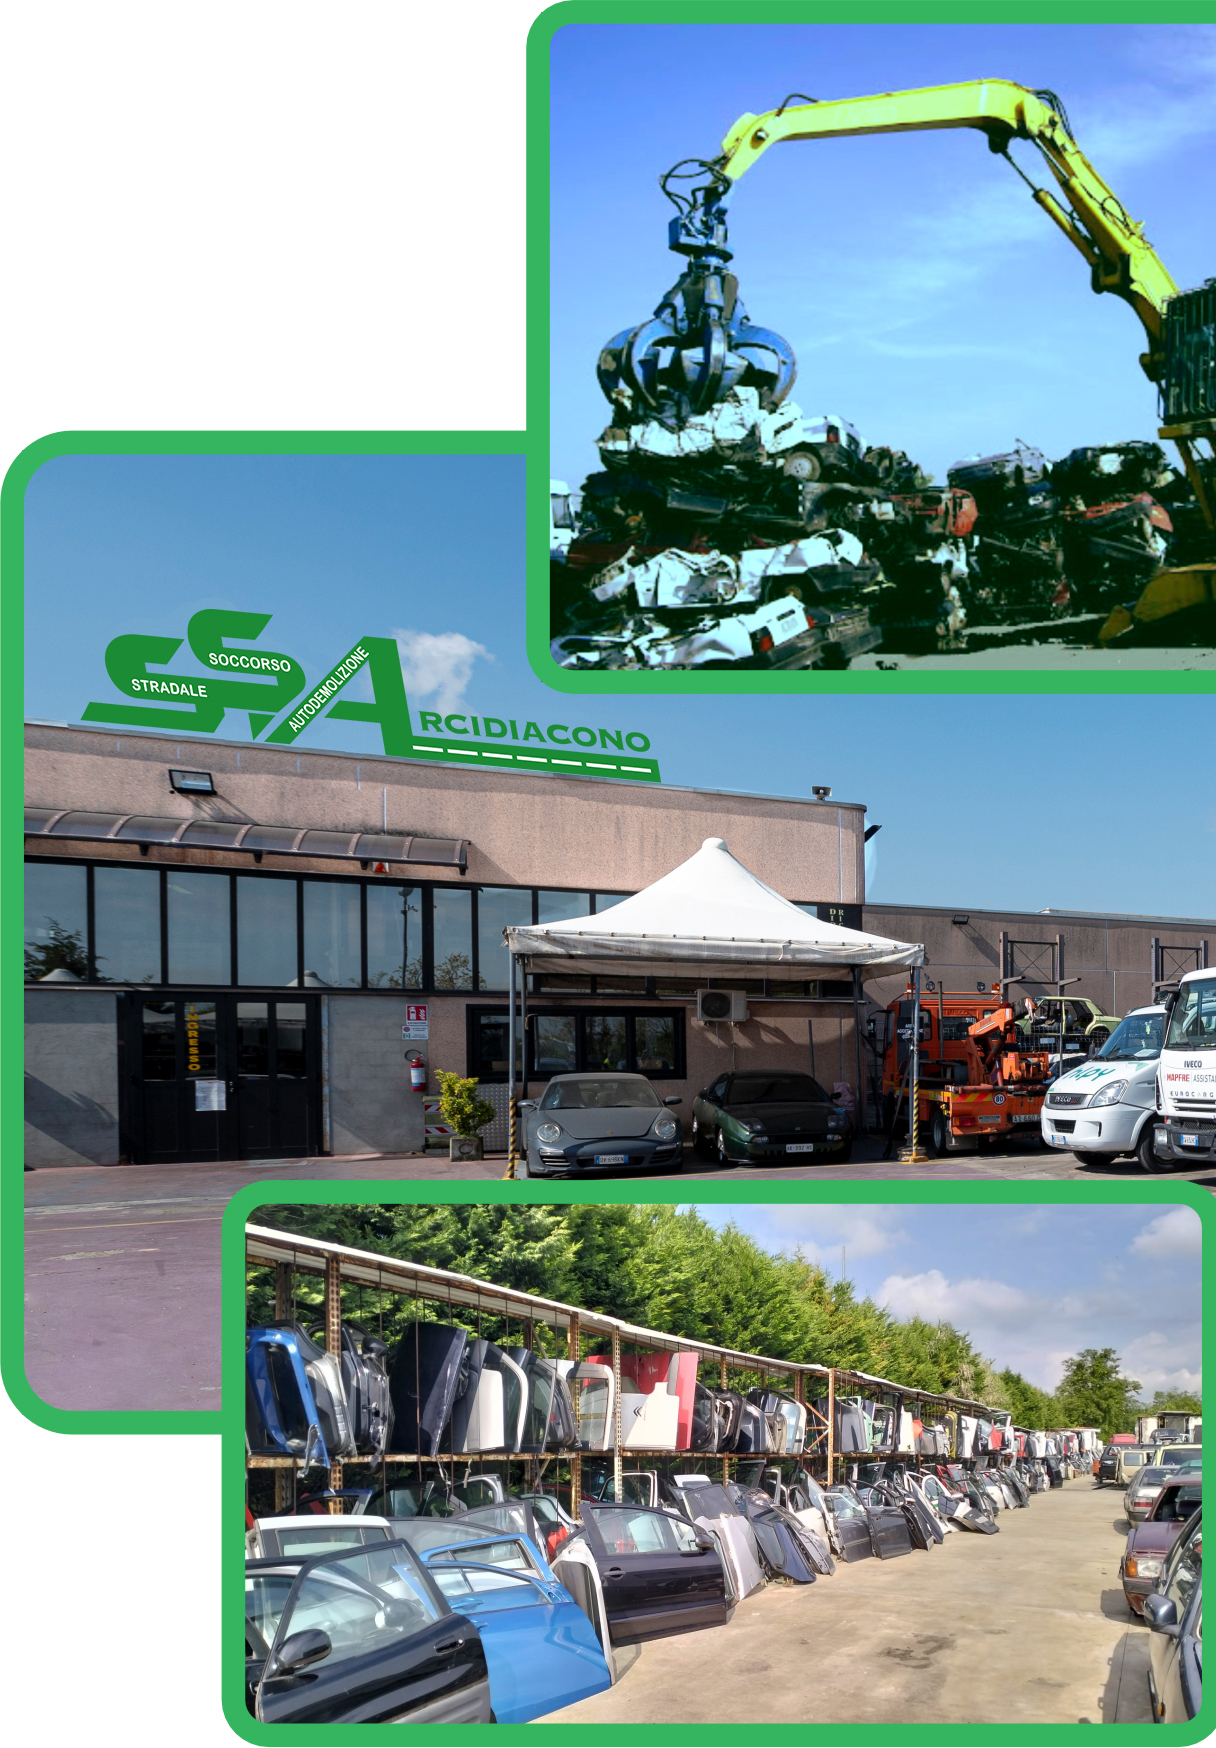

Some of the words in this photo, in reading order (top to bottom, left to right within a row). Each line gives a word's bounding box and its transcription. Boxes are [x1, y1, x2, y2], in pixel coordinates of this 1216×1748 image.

[208, 652, 291, 673] SOCCORSO
[131, 678, 208, 698] STRADALE
[288, 646, 369, 733] AUTODEMOLIZIONE
[187, 1005, 201, 1071] INGRESSO
[1184, 1060, 1203, 1068] IVECO
[1166, 1073, 1190, 1082] MAPFRE
